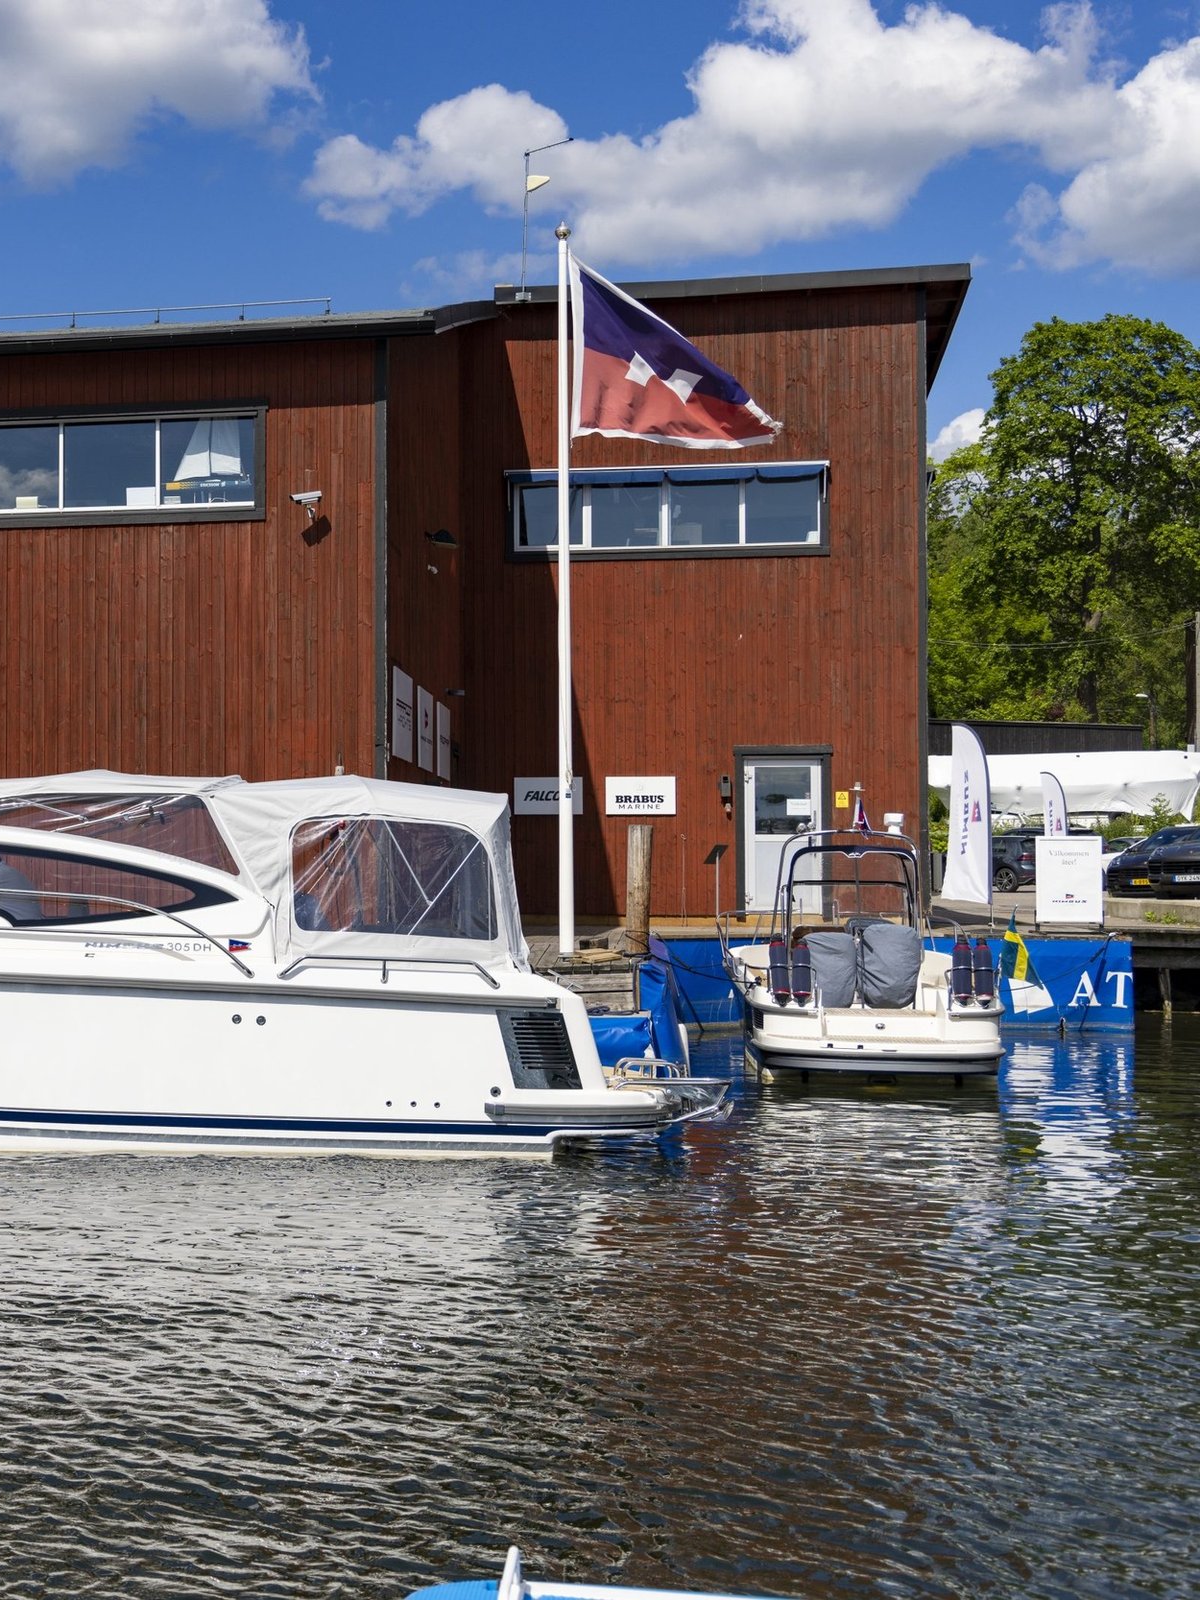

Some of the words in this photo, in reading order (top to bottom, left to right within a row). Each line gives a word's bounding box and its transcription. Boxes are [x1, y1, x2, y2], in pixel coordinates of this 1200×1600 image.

[524, 790, 560, 802] FALCO
[615, 795, 664, 804] BRABUS
[1048, 849, 1090, 857] Välkommen
[166, 942, 190, 952] 305
[193, 943, 212, 952] DH
[1067, 970, 1134, 1009] AT
